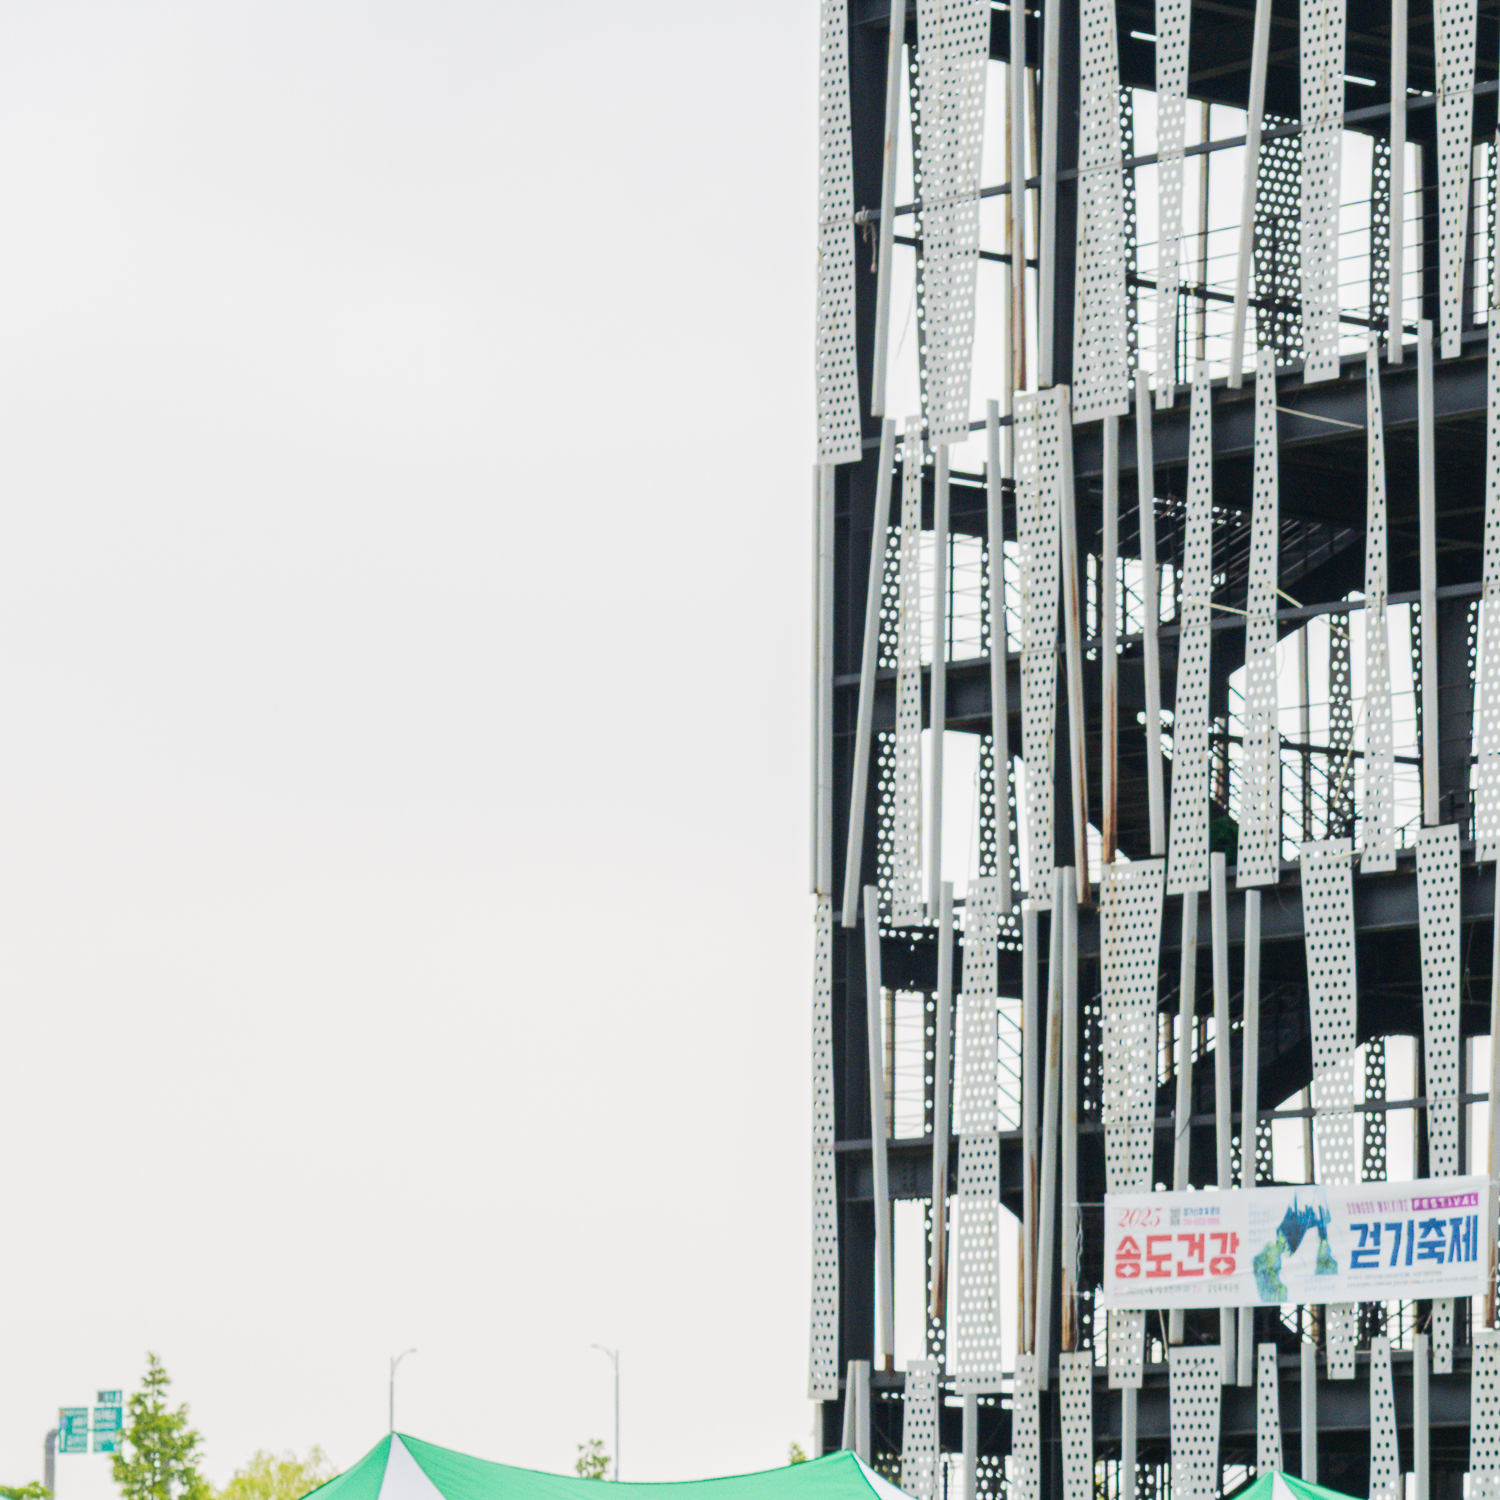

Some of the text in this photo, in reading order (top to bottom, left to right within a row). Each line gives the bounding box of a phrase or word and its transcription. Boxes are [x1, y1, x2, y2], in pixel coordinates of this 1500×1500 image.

[1412, 1194, 1478, 1211] FESTIVAL
[1117, 1206, 1162, 1229] 2025
[1115, 1214, 1479, 1278] 송도건강 걷기축제
